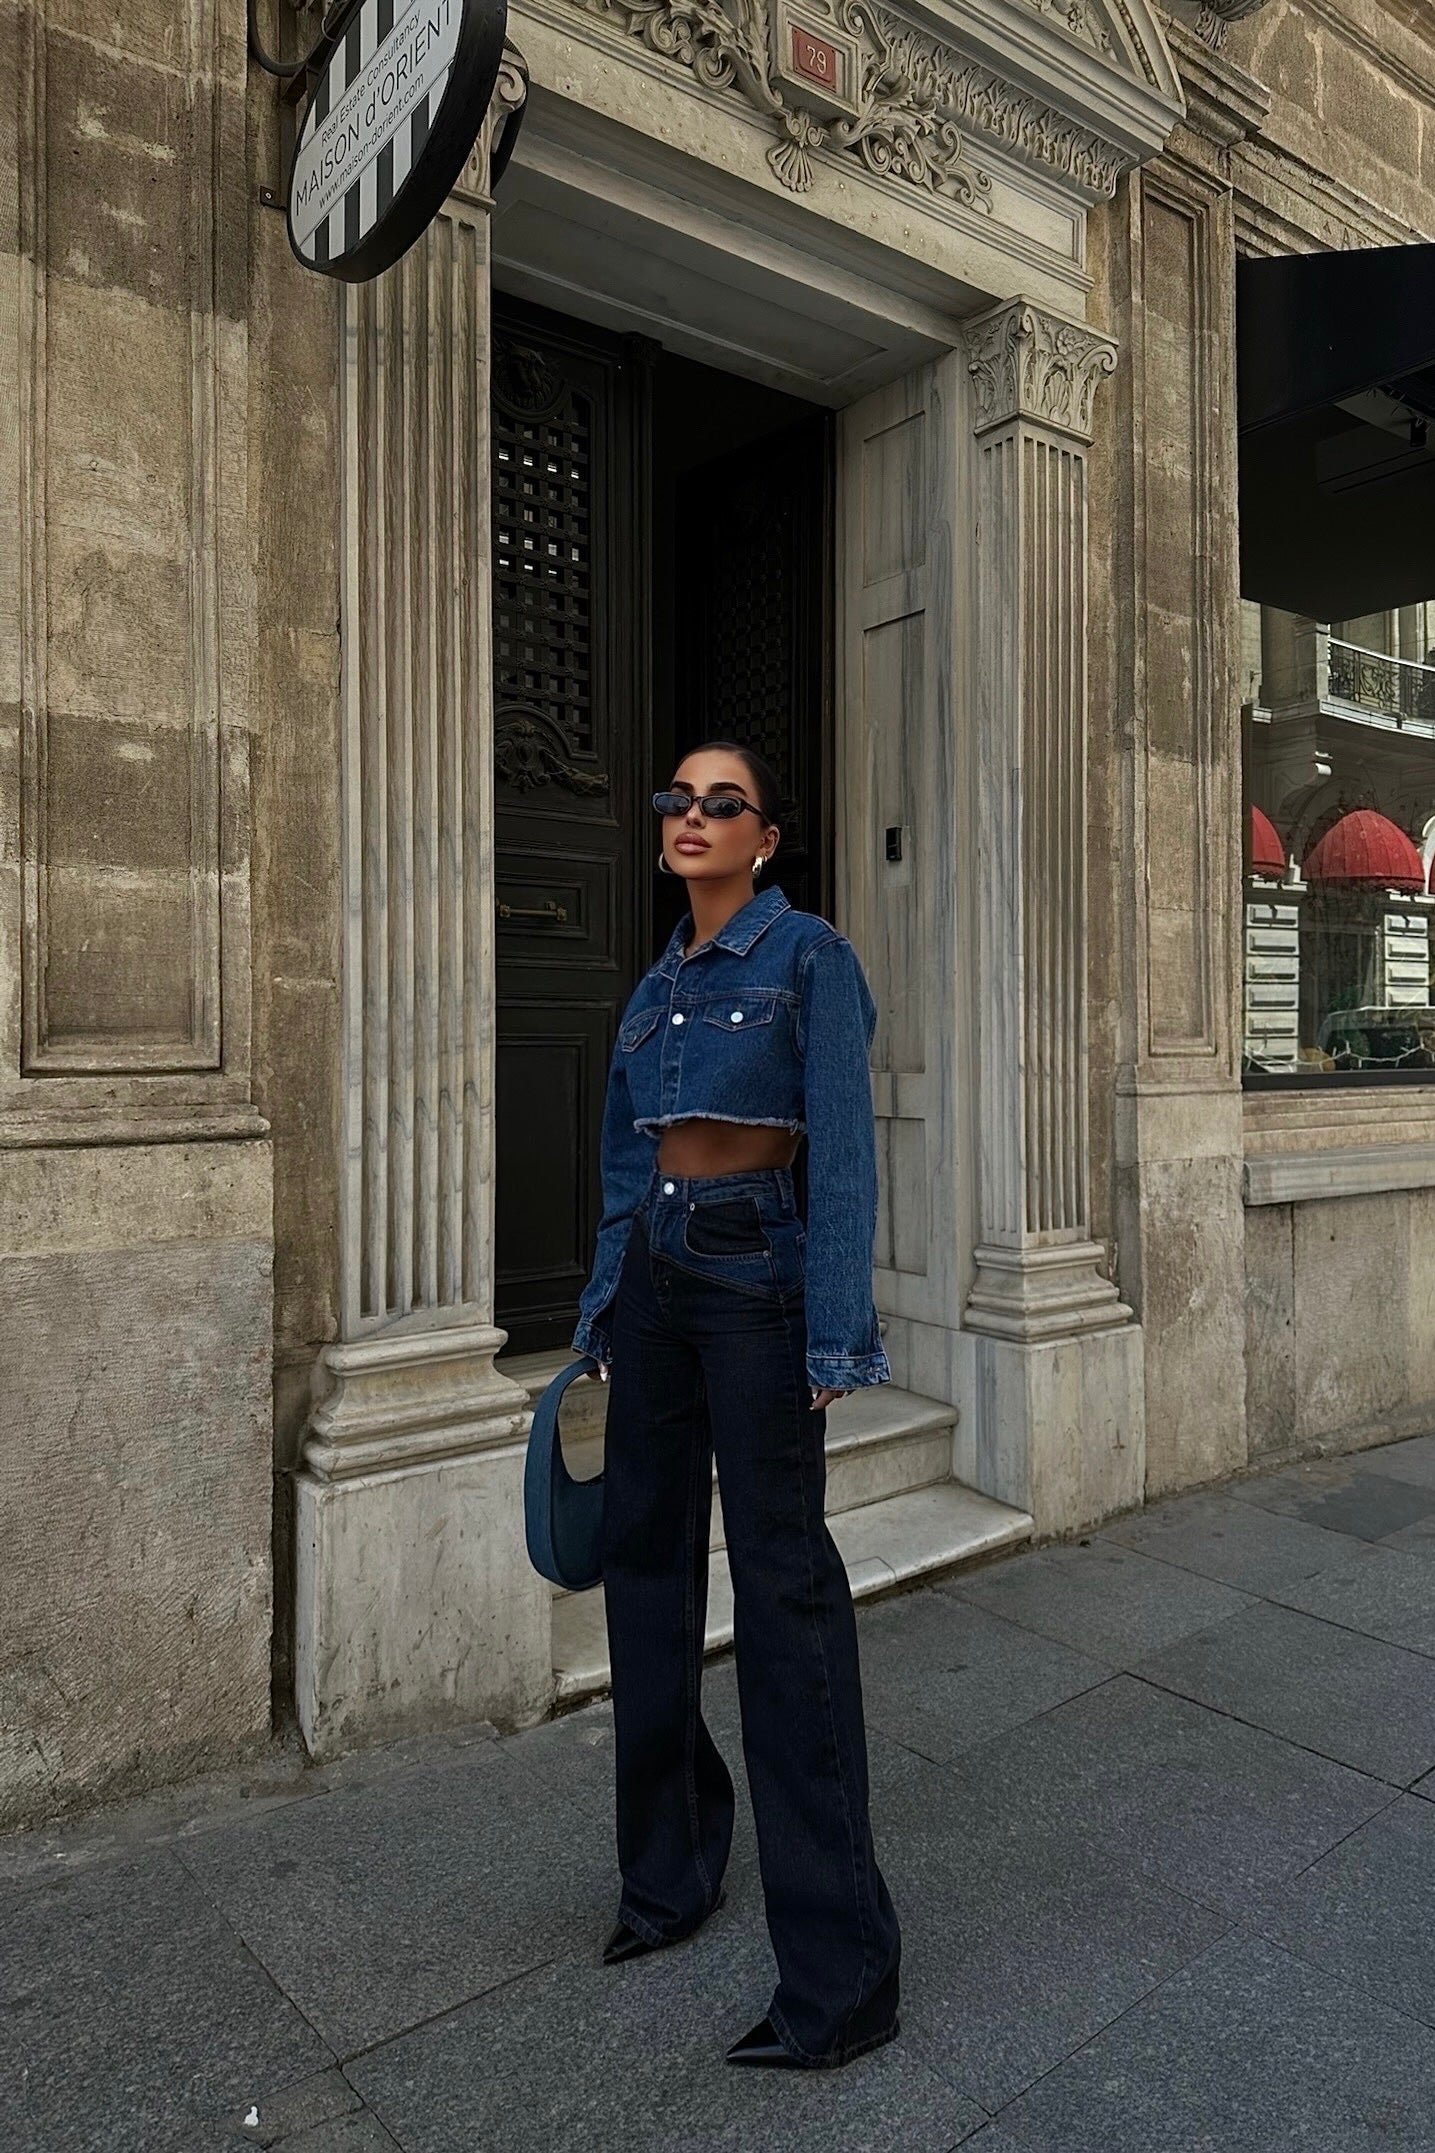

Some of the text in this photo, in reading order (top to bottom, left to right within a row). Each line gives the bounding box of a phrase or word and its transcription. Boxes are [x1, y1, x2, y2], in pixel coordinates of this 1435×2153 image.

[296, 0, 449, 217] MAISON d'ORIENT
[321, 9, 421, 147] Real Estate Consultancy
[806, 44, 827, 75] 79
[319, 73, 424, 208] www.maison-dorient.com
